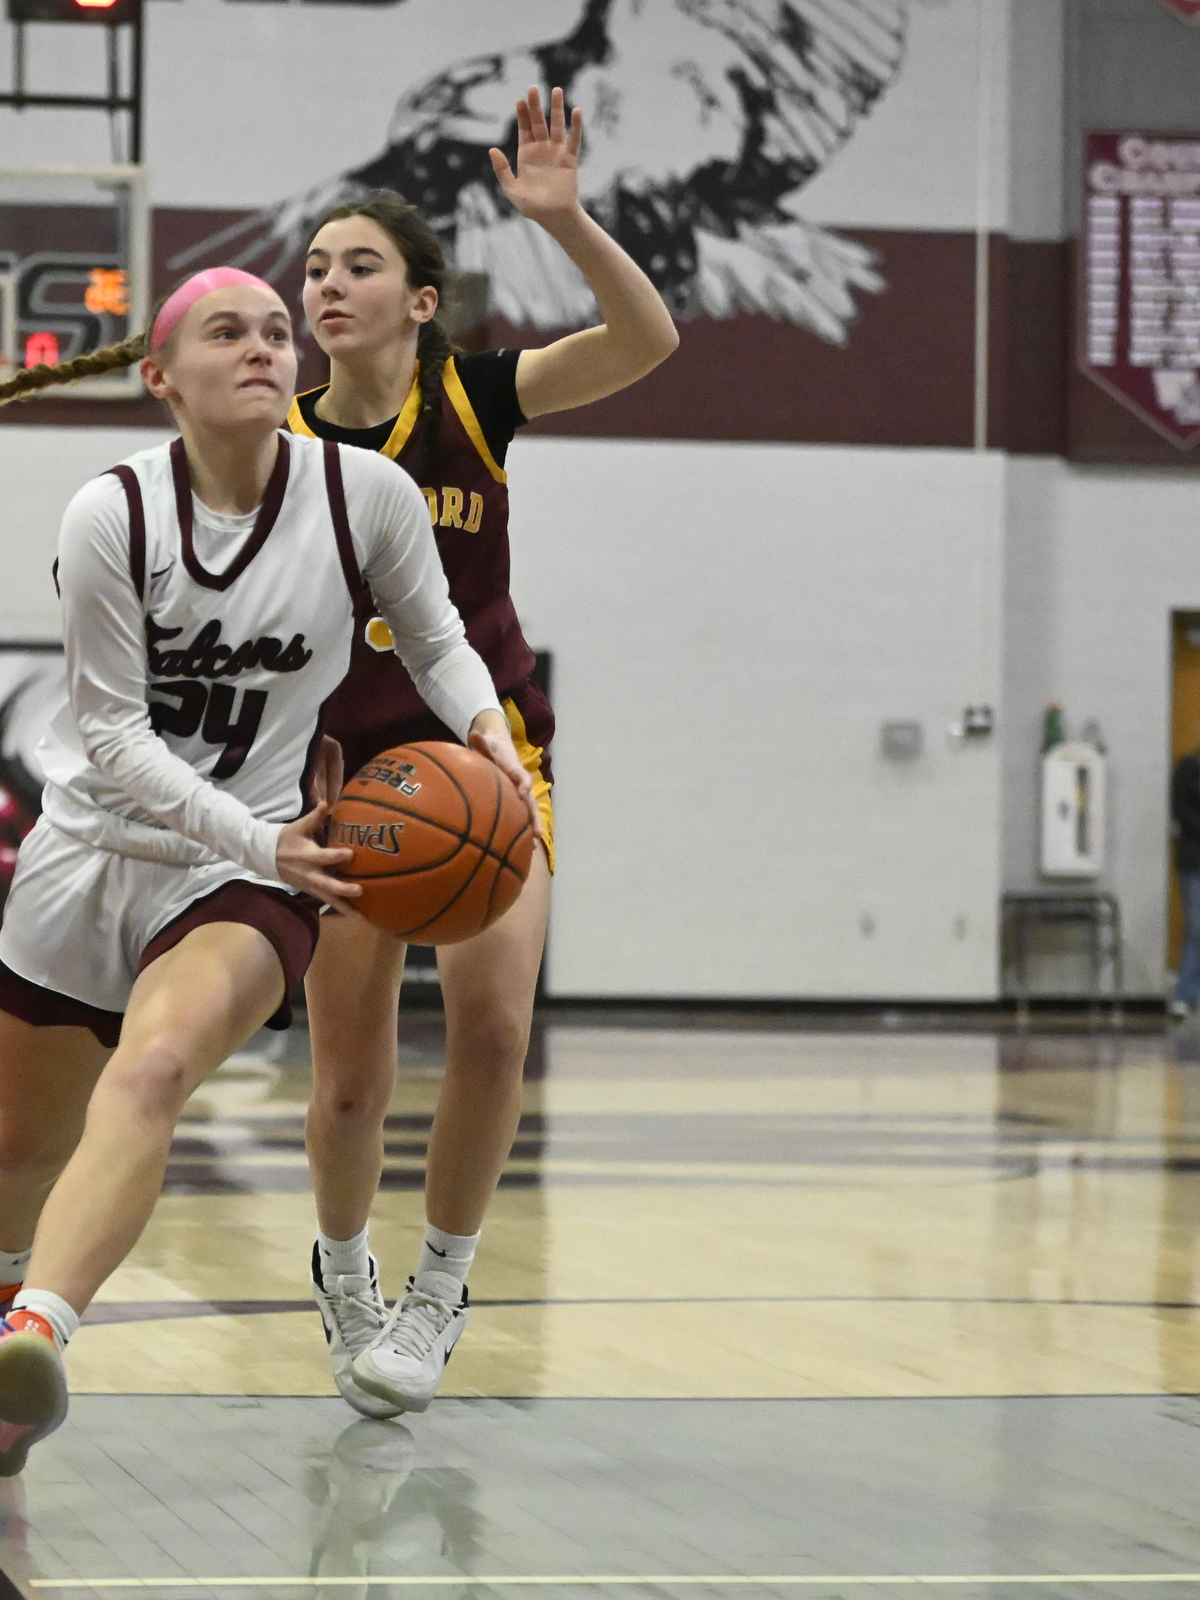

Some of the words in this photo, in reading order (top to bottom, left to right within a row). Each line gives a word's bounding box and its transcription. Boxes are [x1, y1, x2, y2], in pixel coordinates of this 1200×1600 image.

[420, 486, 484, 534] ORD
[145, 613, 313, 679] Falcons
[148, 680, 269, 780] 24
[353, 765, 422, 798] PREC
[332, 822, 405, 856] SPALD
